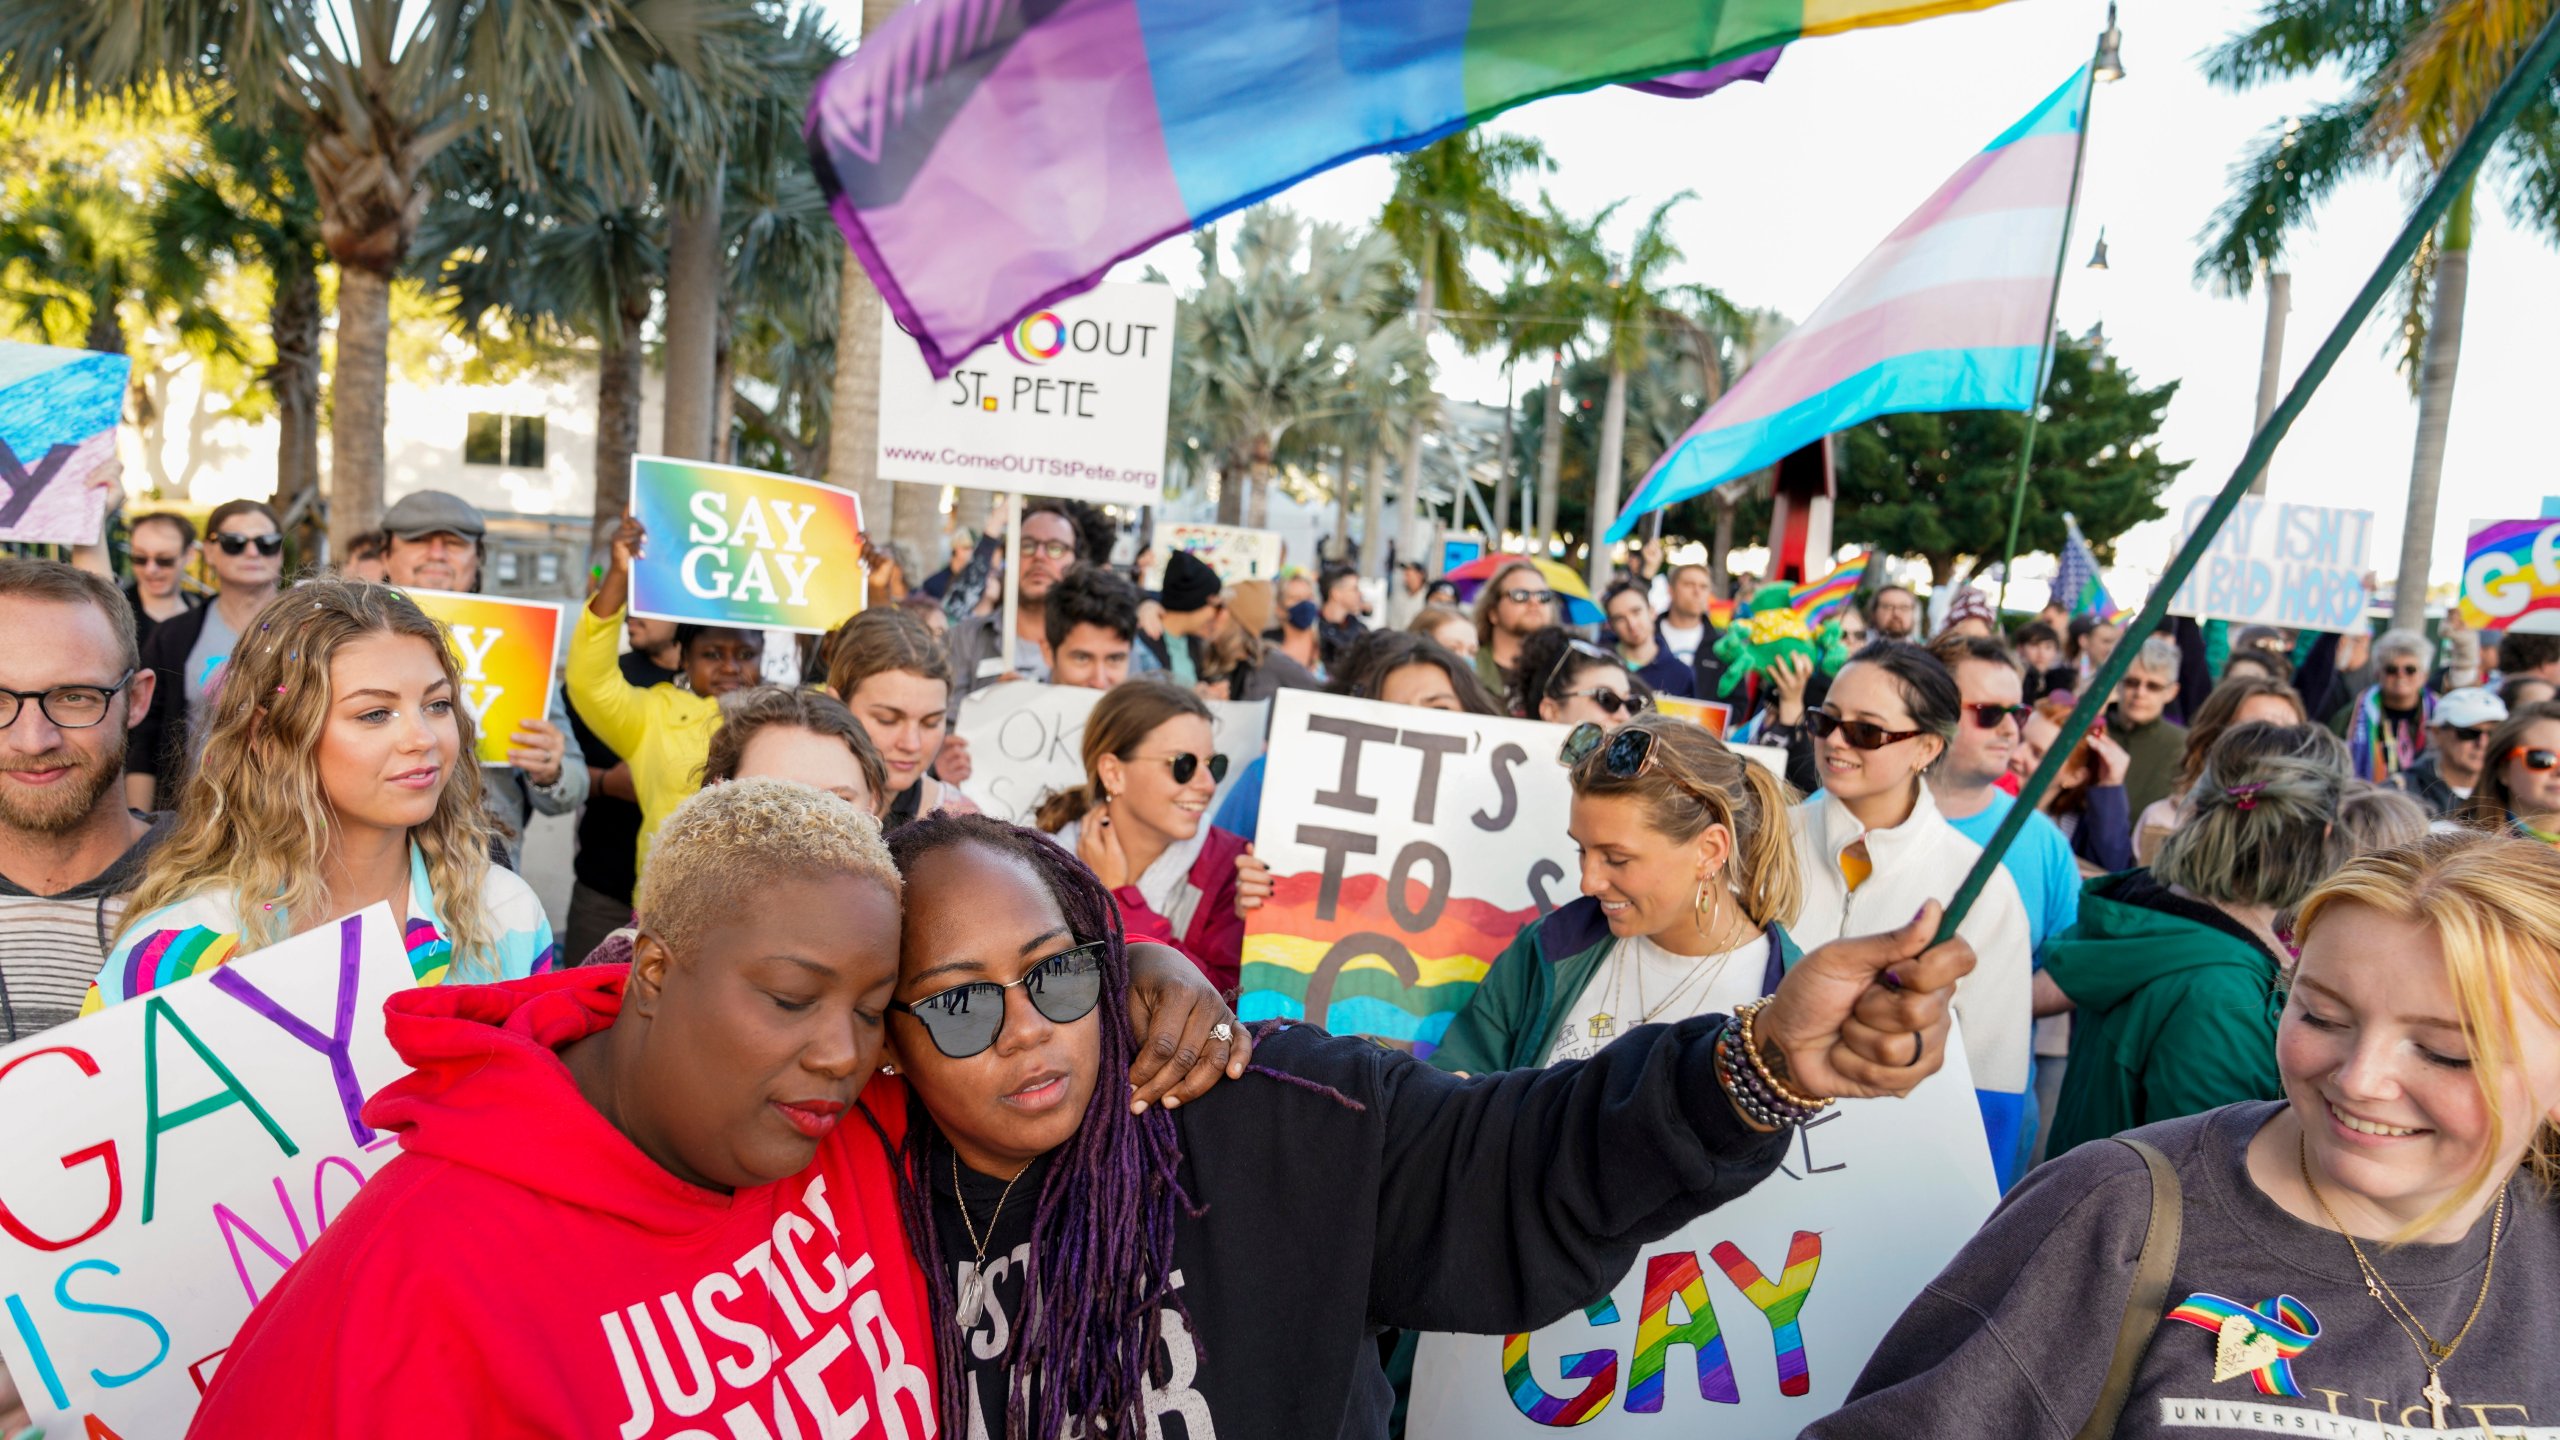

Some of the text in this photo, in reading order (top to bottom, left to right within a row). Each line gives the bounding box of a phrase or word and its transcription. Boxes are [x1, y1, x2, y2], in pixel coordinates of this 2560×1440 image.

[1073, 320, 1157, 357] OUT
[1013, 377, 1099, 418] PETE
[885, 446, 1158, 487] www.ComeOUTStPete.org
[689, 490, 816, 553] SAY
[680, 545, 821, 606] GAY
[2205, 554, 2272, 617] BAD
[2277, 561, 2365, 627] WORD
[1307, 713, 1528, 832] IT'S
[1295, 824, 1452, 934] TO
[0, 914, 377, 1252] GAY
[6, 1259, 170, 1410] IS
[661, 1290, 938, 1440] ER
[1502, 1230, 1822, 1427] GAY
[2175, 1405, 2360, 1439] UNIVERSITY
